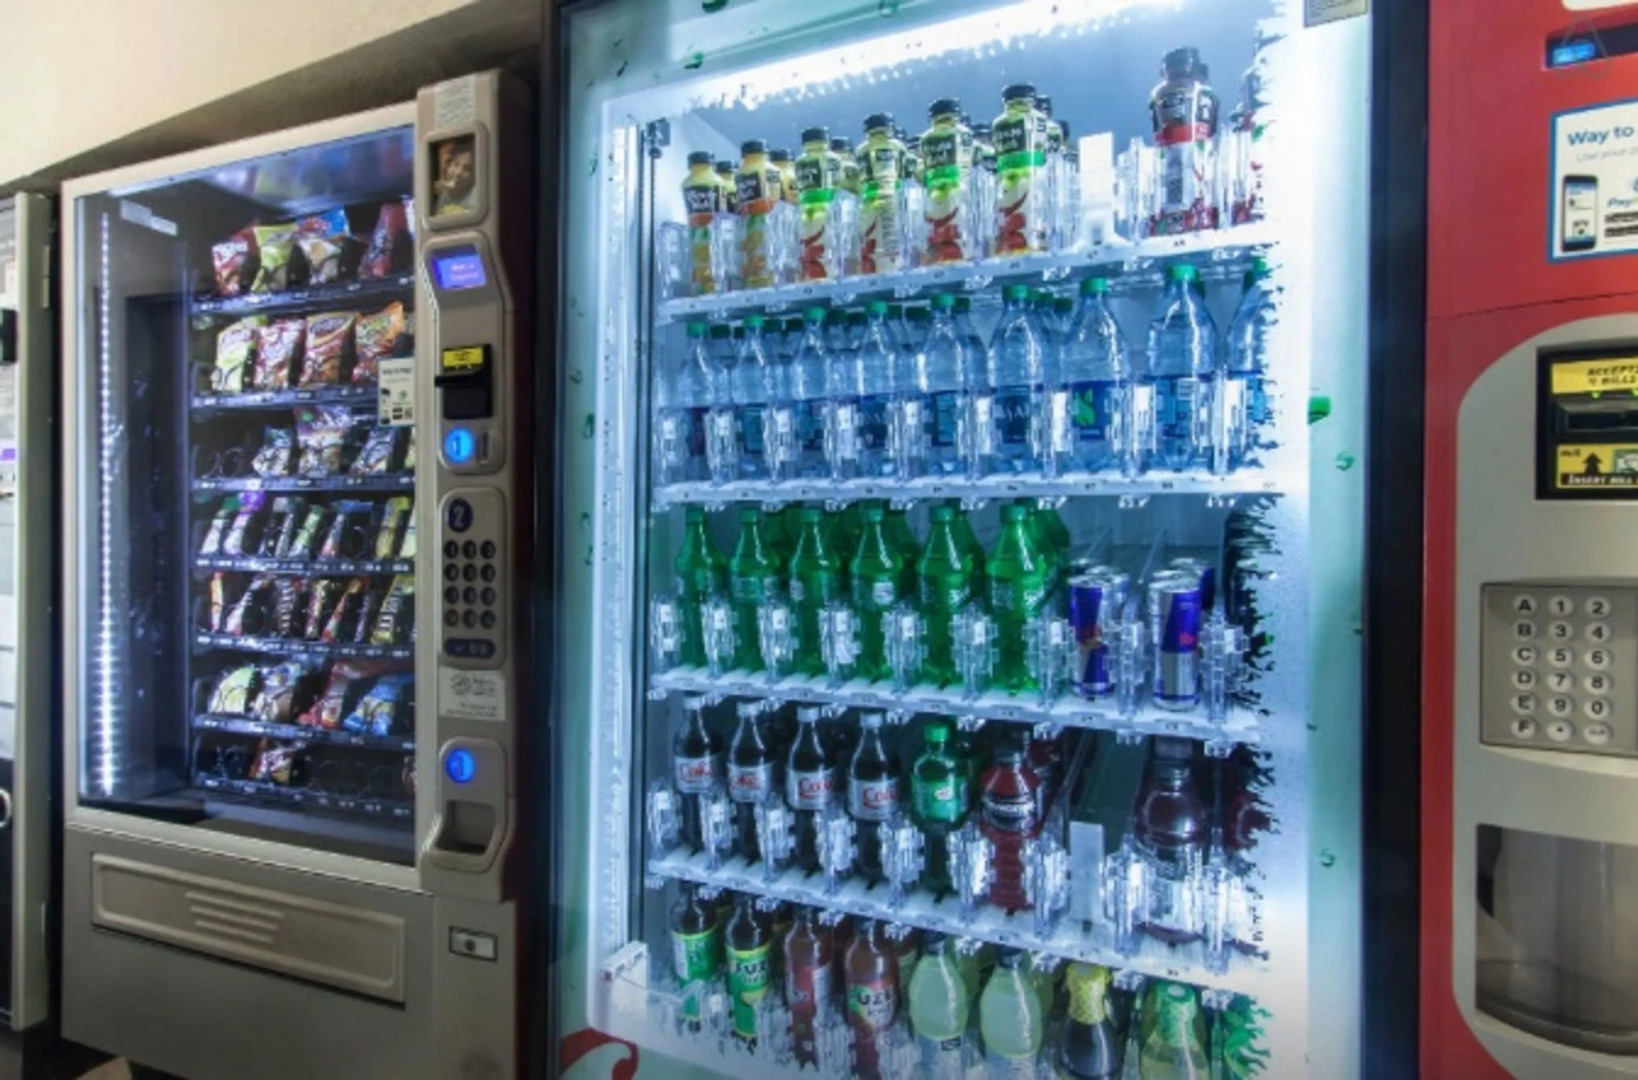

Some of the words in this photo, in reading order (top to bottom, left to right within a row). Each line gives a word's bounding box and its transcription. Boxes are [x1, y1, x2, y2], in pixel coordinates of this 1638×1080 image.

[1568, 129, 1609, 146] Way
[1613, 125, 1634, 138] to
[452, 505, 465, 528] 2
[1518, 598, 1532, 612] A
[1557, 600, 1565, 613] 1
[1592, 602, 1604, 615] 2
[1518, 624, 1532, 637] B
[1555, 624, 1567, 637] 3
[1592, 626, 1604, 639] 4
[1517, 649, 1532, 661] C
[1555, 649, 1566, 662] 5
[1592, 651, 1604, 664] 6
[1518, 671, 1532, 684] D
[1555, 673, 1566, 686] 7
[1592, 676, 1604, 689] 8
[1518, 696, 1531, 710] E
[1555, 699, 1566, 712] 9
[1592, 702, 1603, 715] 0
[1518, 719, 1530, 733] F
